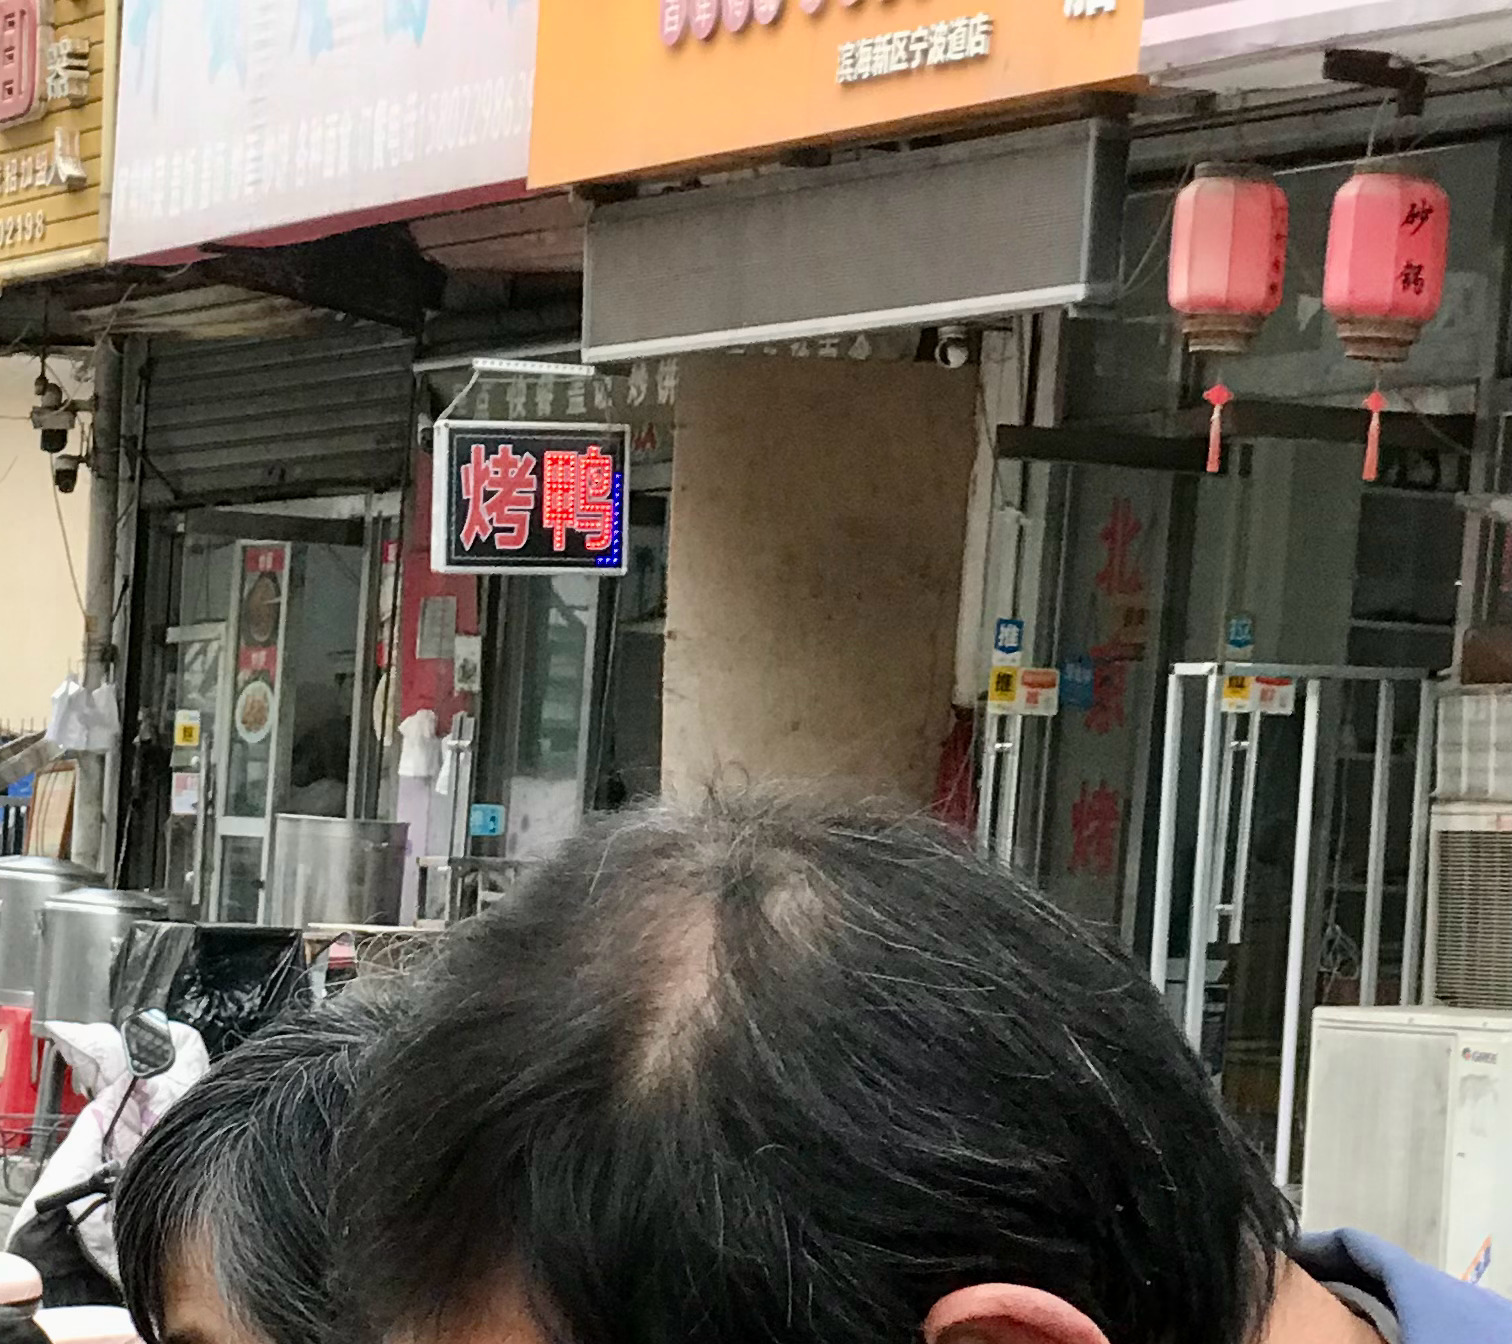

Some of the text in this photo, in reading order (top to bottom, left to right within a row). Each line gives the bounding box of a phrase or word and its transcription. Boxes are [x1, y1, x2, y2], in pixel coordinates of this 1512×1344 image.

[837, 12, 992, 84] 滨海新区宁波道店
[460, 443, 614, 551] 烤鸭
